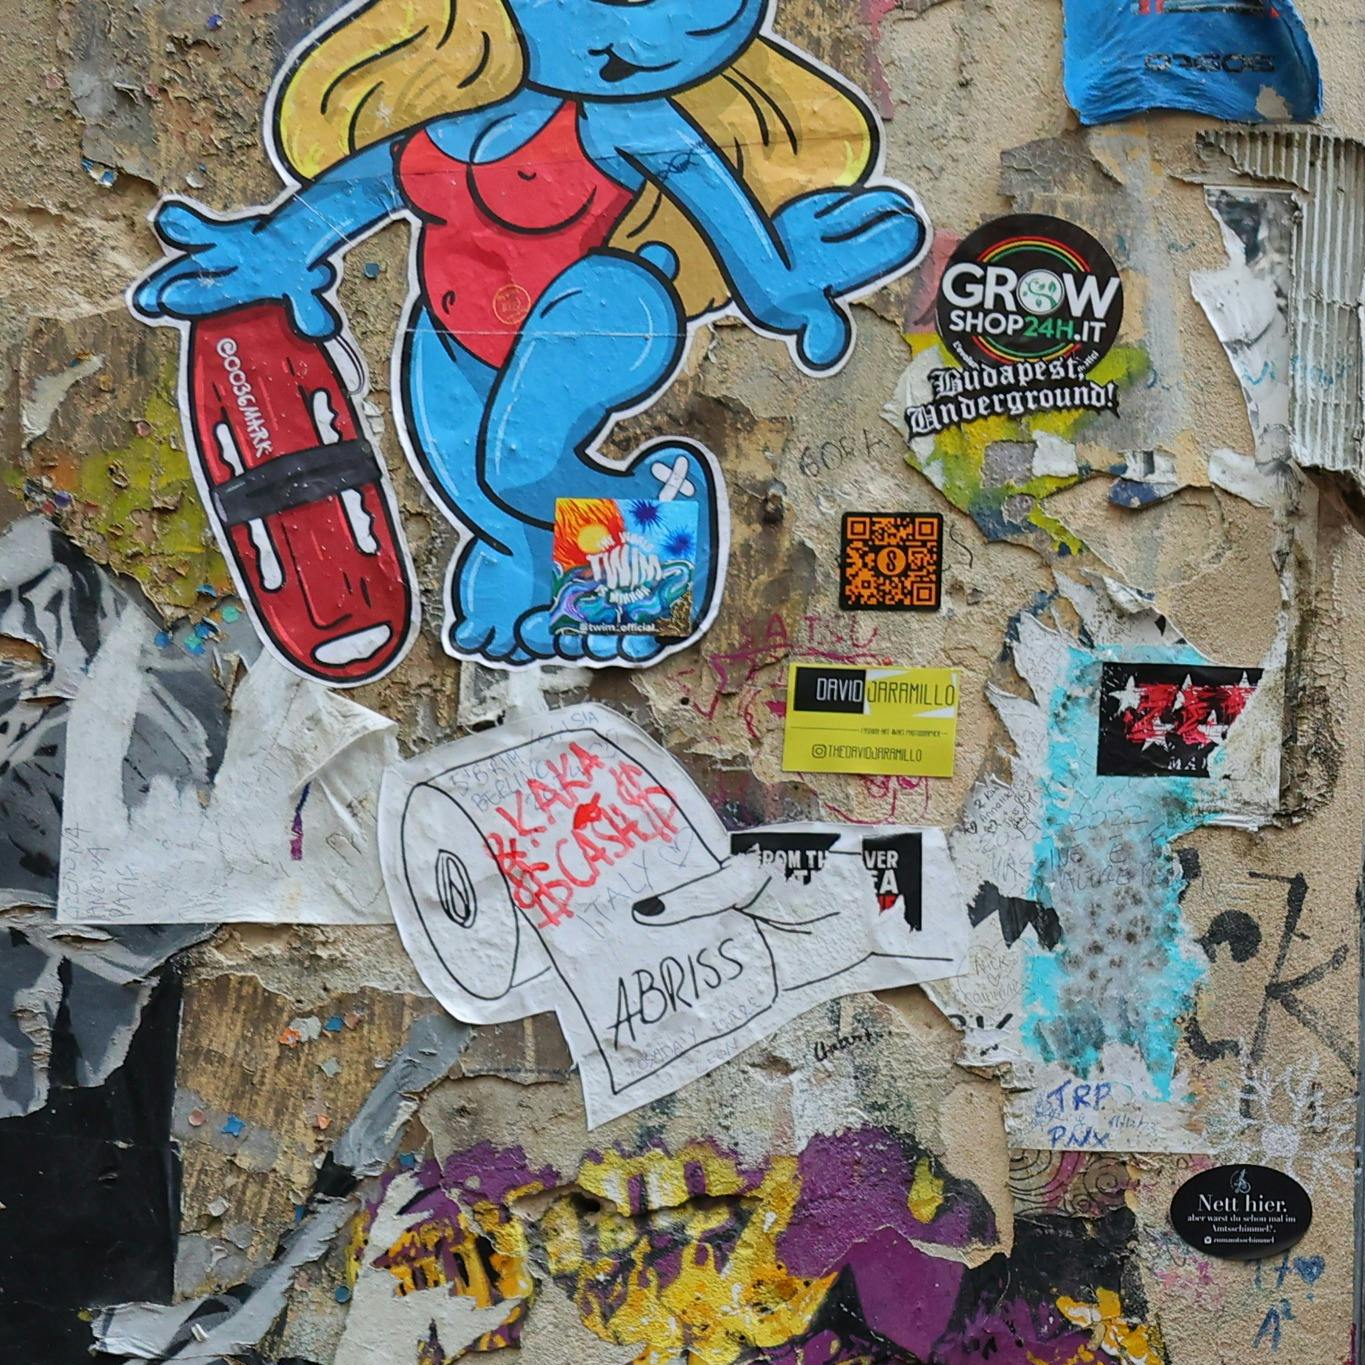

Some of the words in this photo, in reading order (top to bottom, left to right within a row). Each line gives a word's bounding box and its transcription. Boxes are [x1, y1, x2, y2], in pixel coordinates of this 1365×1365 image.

[941, 261, 1121, 320] GROW
[949, 309, 1107, 343] SHOP24H.IT
[906, 381, 1117, 434] Underground!
[815, 676, 864, 704] DAVID
[866, 679, 956, 707] JARAMILLO
[827, 743, 923, 763] THEDAVIDJARAMILLO
[606, 937, 744, 1051] ABRISS
[1047, 1078, 1112, 1112] TRP
[1047, 1125, 1112, 1149] PNX
[1187, 1214, 1206, 1224] aber
[1207, 1214, 1228, 1224] warst
[1229, 1213, 1241, 1224] du
[1242, 1213, 1267, 1224] schon
[1268, 1213, 1284, 1224] mal
[1285, 1214, 1297, 1224] im
[1197, 1192, 1240, 1214] Nett
[1245, 1192, 1288, 1214] hier.
